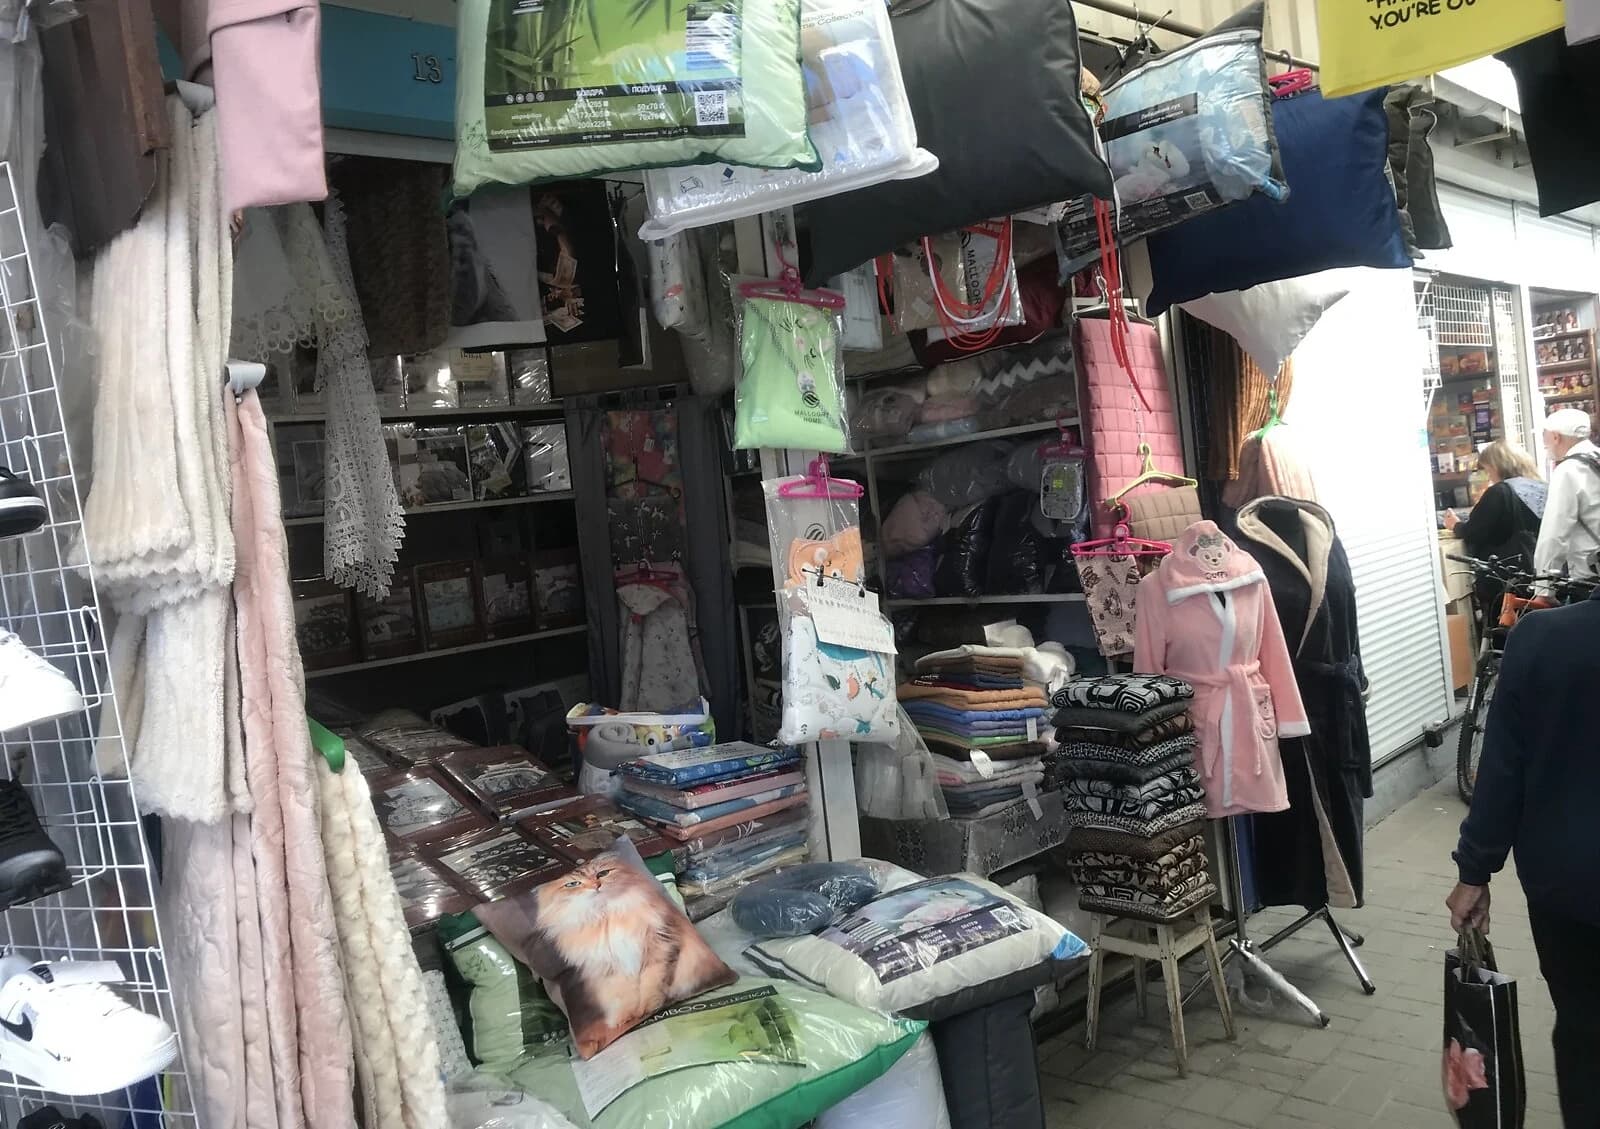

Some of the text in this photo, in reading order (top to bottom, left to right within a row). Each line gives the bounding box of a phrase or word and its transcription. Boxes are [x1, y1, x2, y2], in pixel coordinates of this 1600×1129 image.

[1369, 0, 1441, 30] YOU'RE
[411, 54, 442, 84] 13
[631, 83, 668, 94] ПОДУШКА
[967, 248, 981, 306] MALLOOR
[644, 1002, 708, 1027] AMBOO
